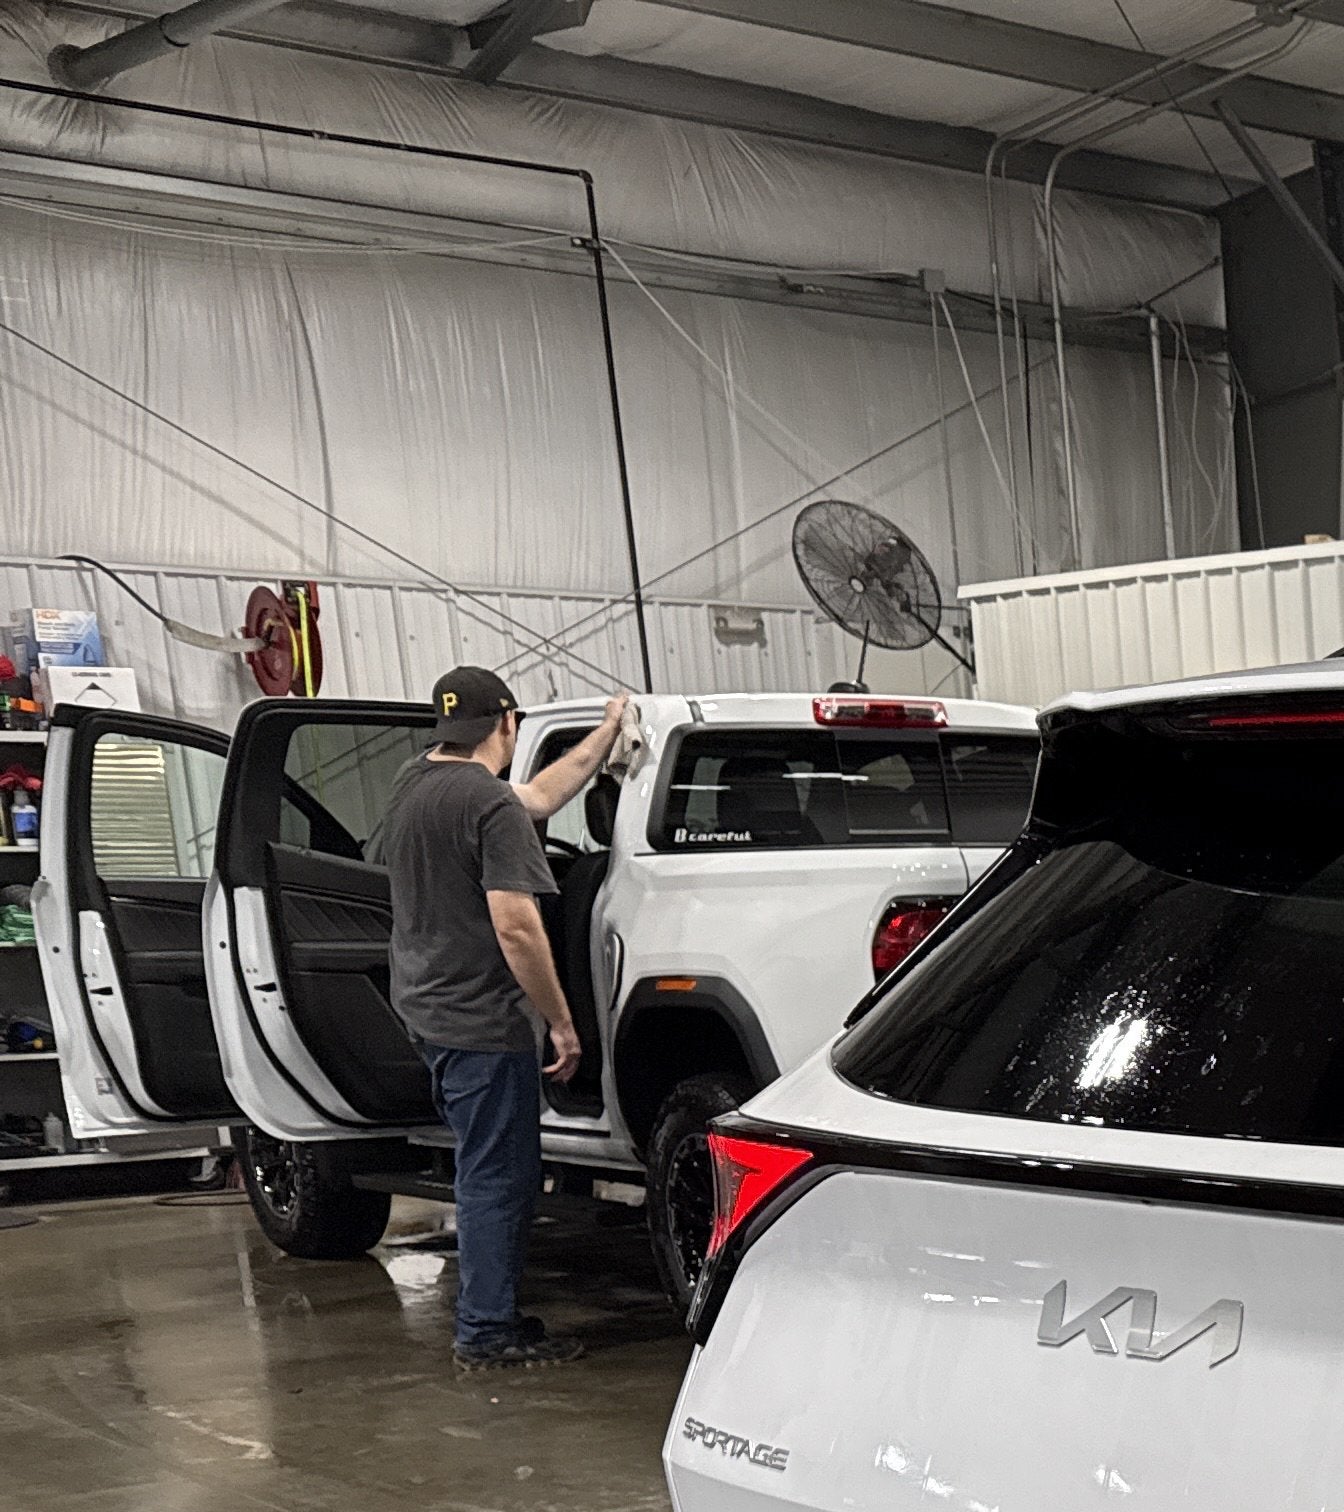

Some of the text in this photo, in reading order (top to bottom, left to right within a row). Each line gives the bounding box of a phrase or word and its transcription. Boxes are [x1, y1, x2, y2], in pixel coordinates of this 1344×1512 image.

[442, 692, 458, 716] P
[1037, 1279, 1244, 1369] KIA
[683, 1416, 790, 1472] SPORTAGE
